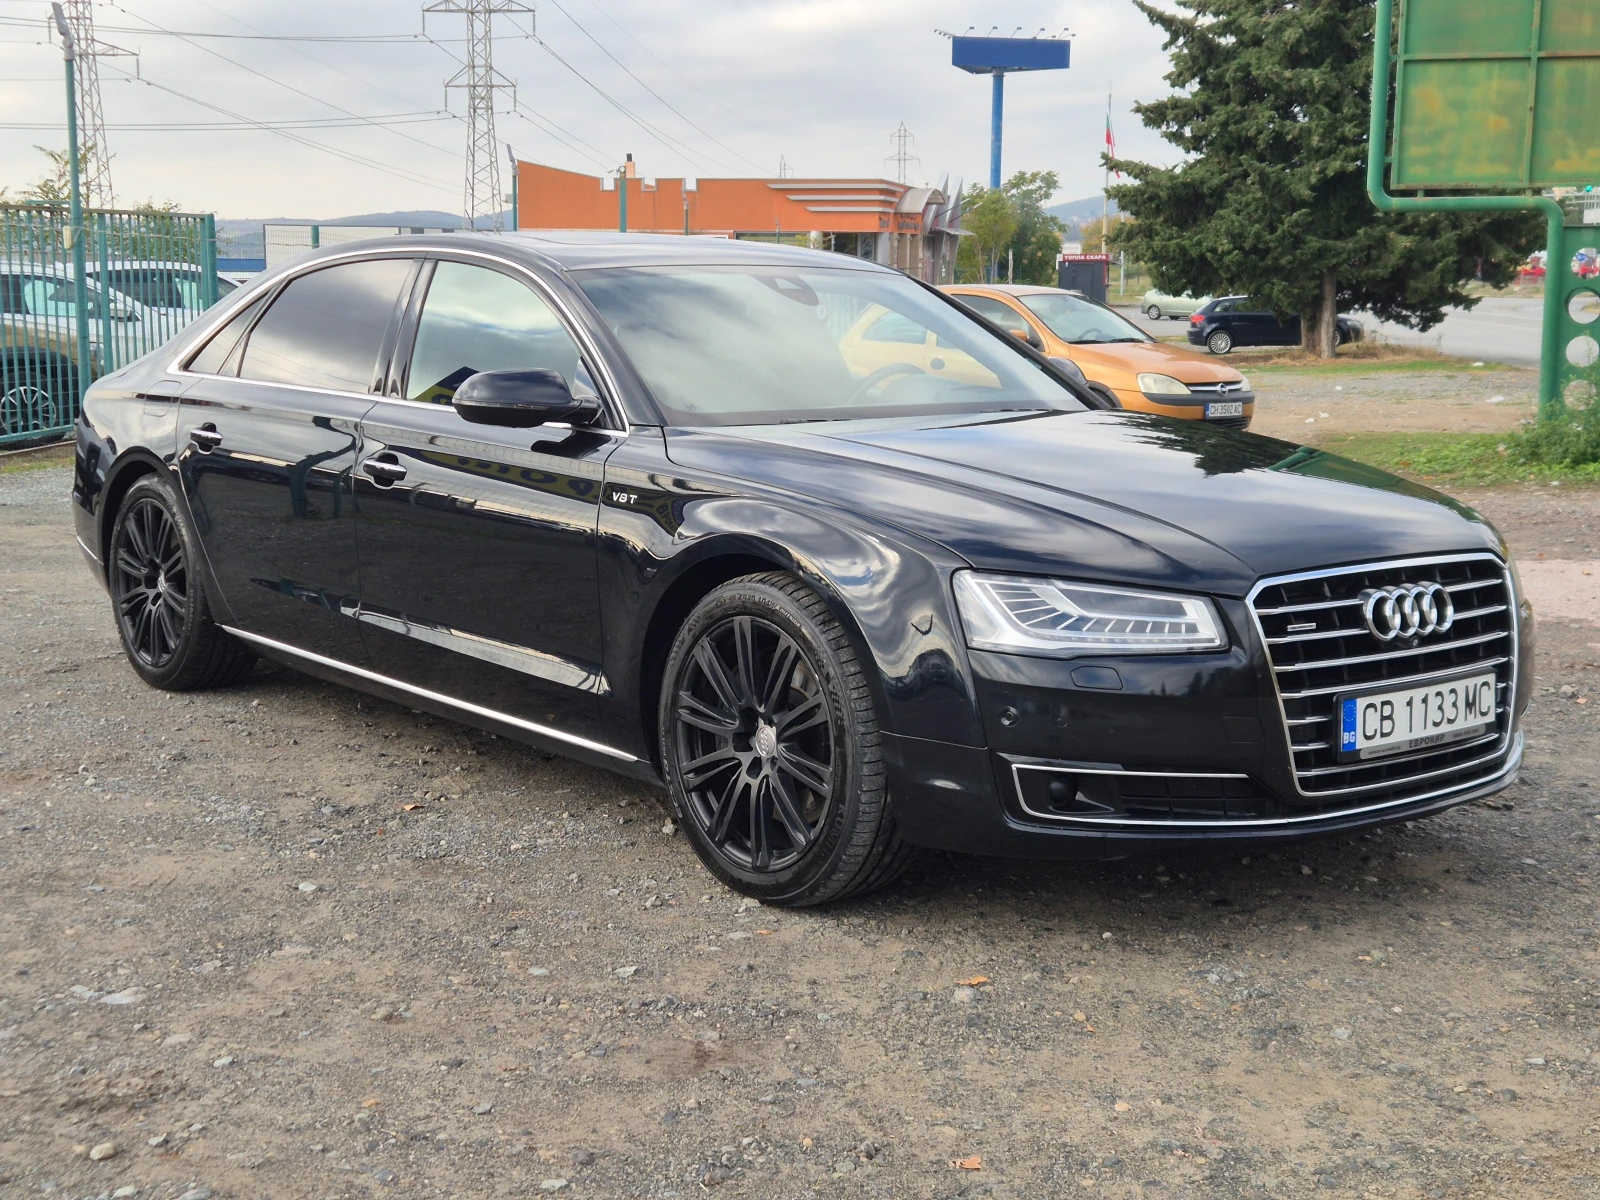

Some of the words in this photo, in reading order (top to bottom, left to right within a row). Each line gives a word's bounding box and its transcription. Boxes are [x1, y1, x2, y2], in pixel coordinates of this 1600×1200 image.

[612, 491, 628, 503] V8
[629, 494, 638, 504] T
[1362, 700, 1395, 741] CB
[1406, 687, 1459, 734] 1133
[1464, 680, 1491, 722] MC
[1343, 731, 1356, 744] BG
[1408, 733, 1446, 749] ЕВРОКАР
